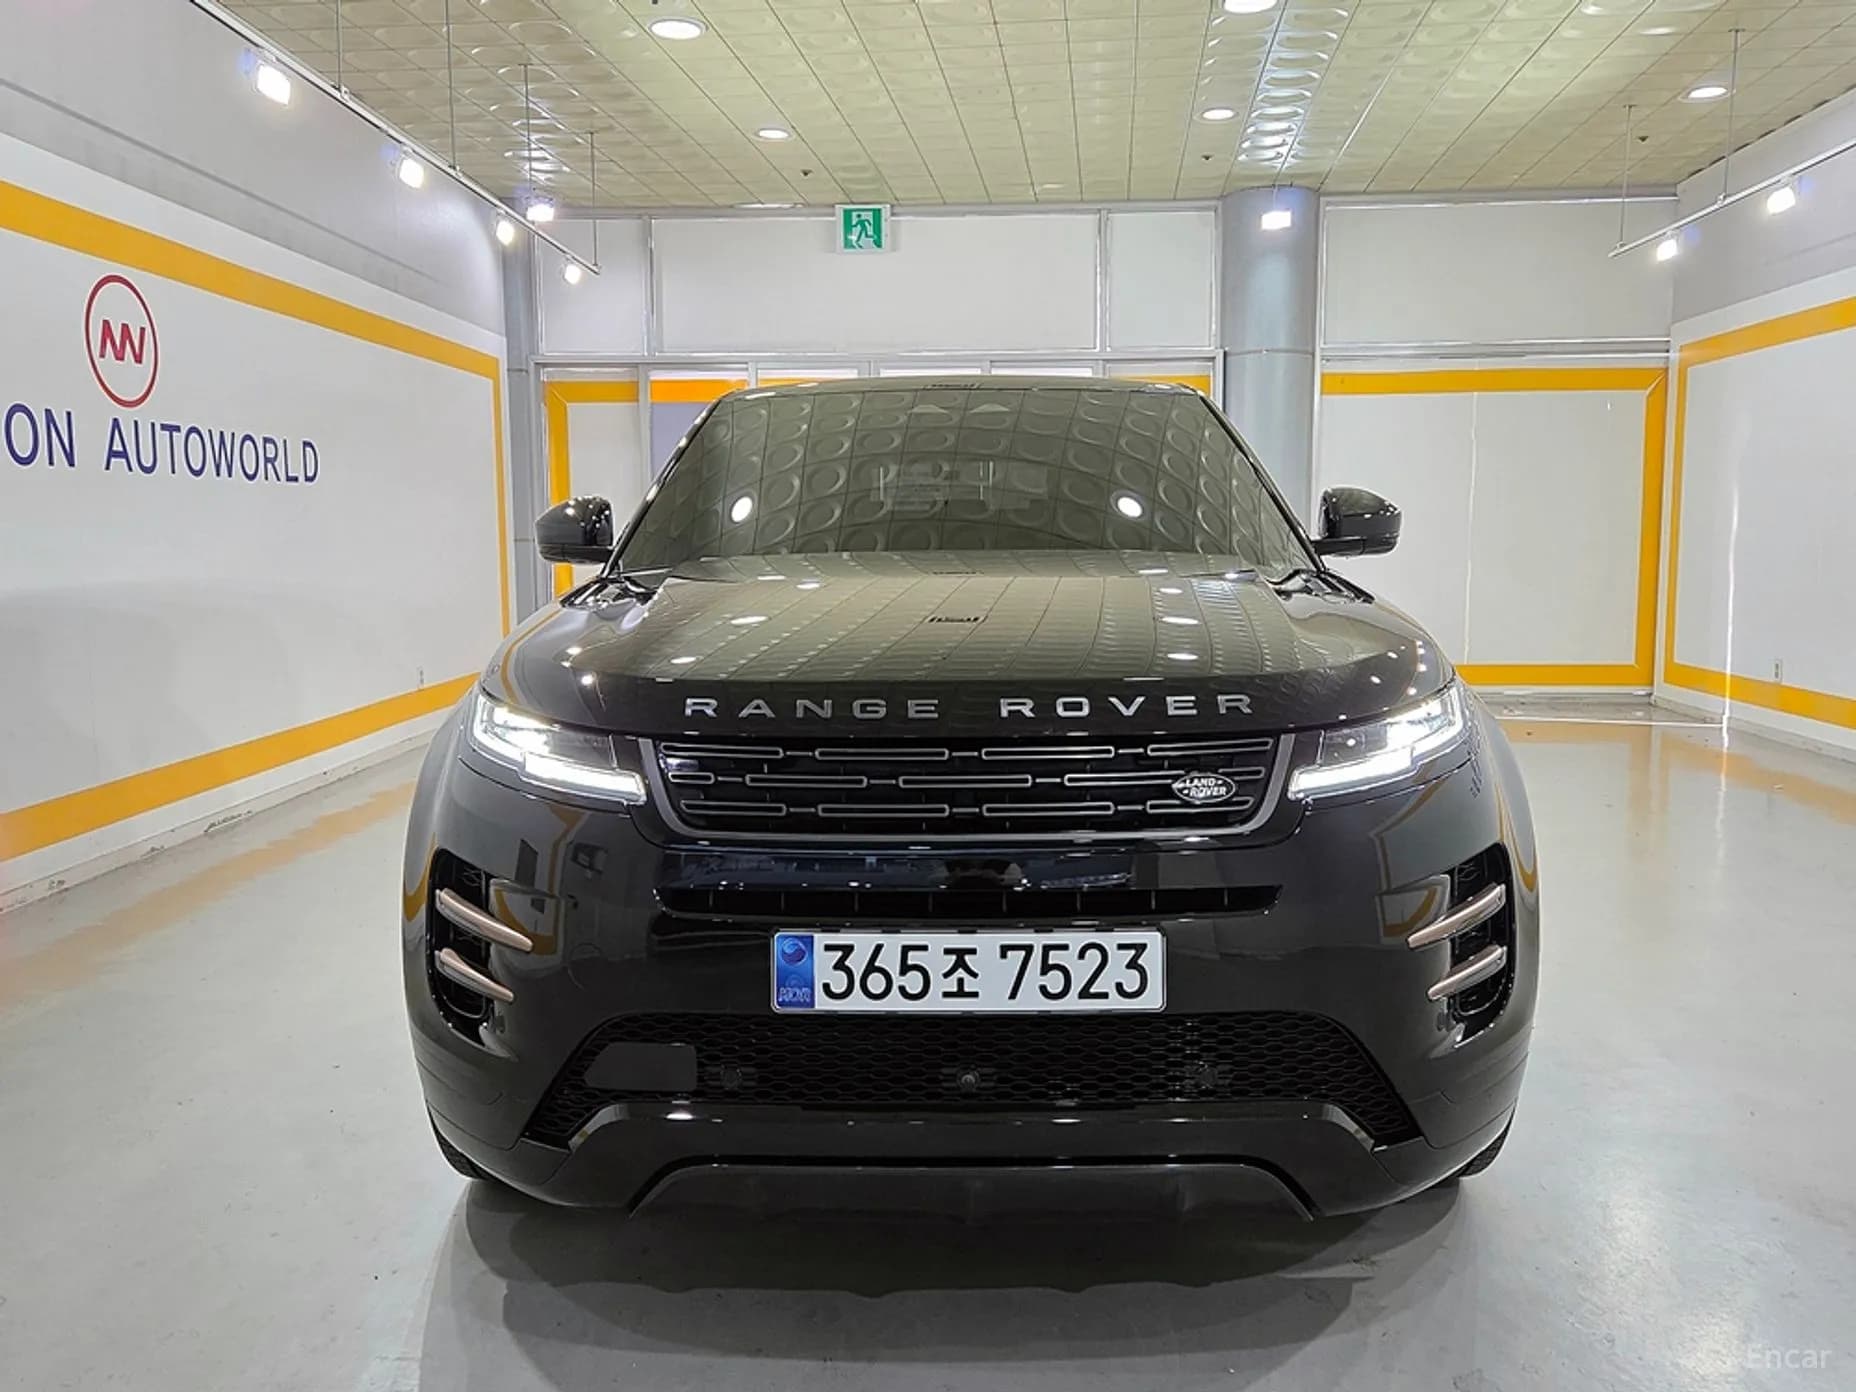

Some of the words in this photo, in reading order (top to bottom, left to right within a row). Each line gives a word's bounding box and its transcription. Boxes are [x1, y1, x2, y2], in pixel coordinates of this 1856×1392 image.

[5, 403, 76, 467] ON
[104, 417, 319, 483] AUTOWORLD
[684, 697, 939, 718] RANGE
[999, 694, 1253, 718] ROVER
[1190, 786, 1227, 797] ROVER
[821, 943, 980, 1000] 365조
[999, 942, 1149, 1000] 7523
